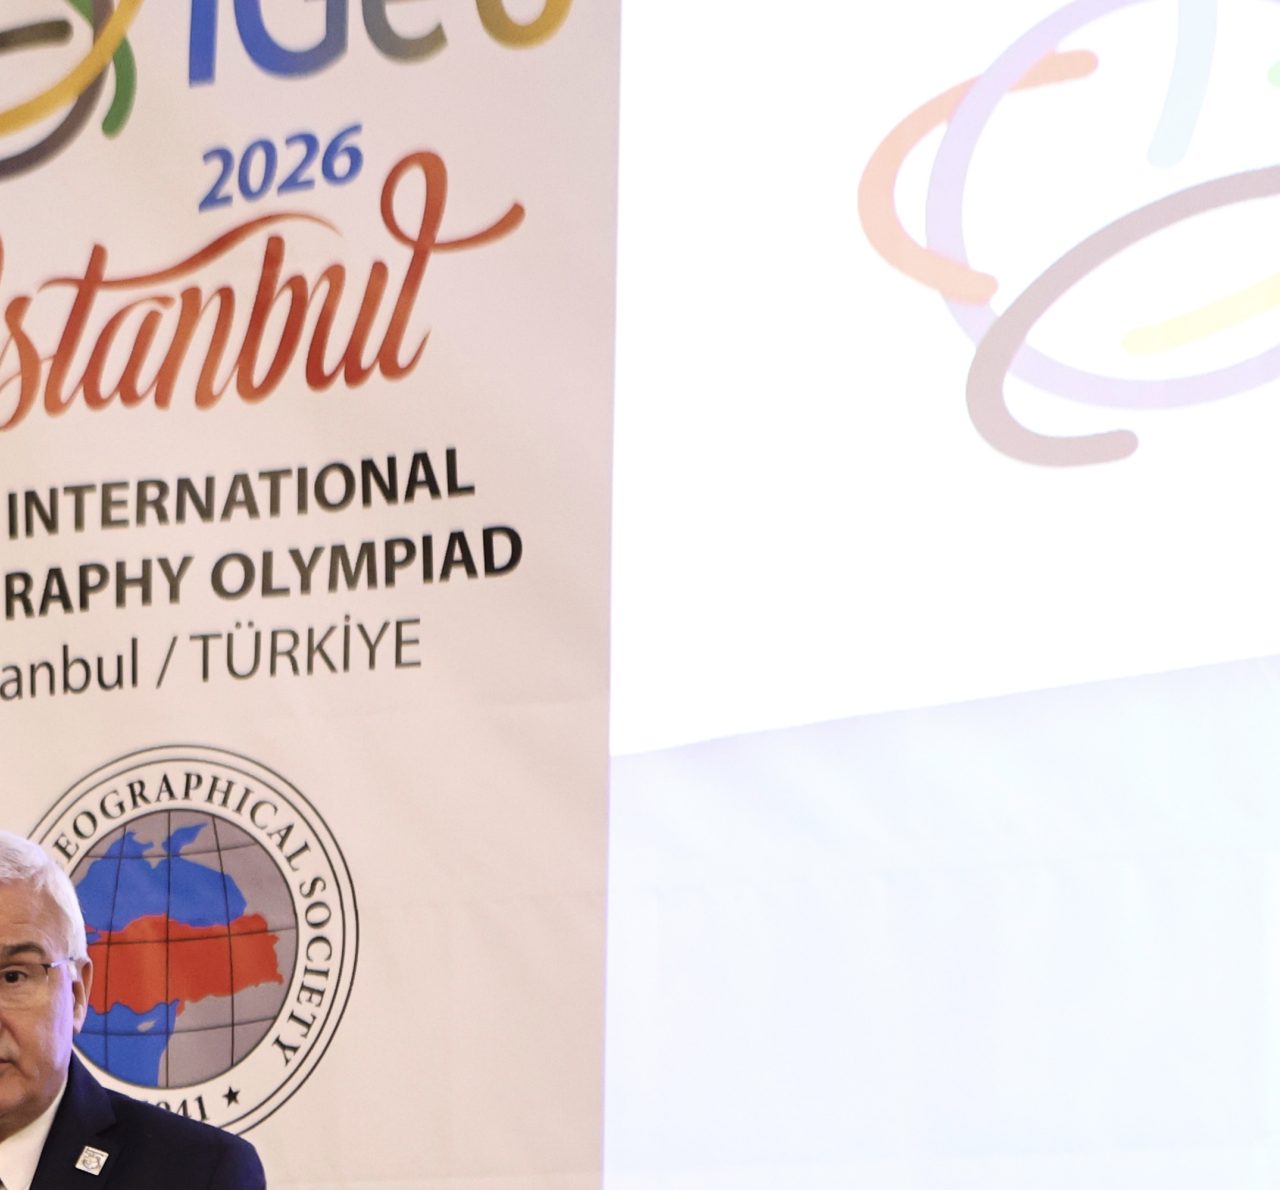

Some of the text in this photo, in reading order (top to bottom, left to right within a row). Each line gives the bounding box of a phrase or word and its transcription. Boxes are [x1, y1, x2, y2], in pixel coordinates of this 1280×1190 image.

[198, 121, 364, 213] 2026
[7, 446, 476, 540] INTERNATIONAL
[210, 523, 524, 602] OLYMPIAD
[188, 614, 424, 685] TÜRKİYE
[52, 773, 333, 1067] EOGRAPHICAL SOCIETY
